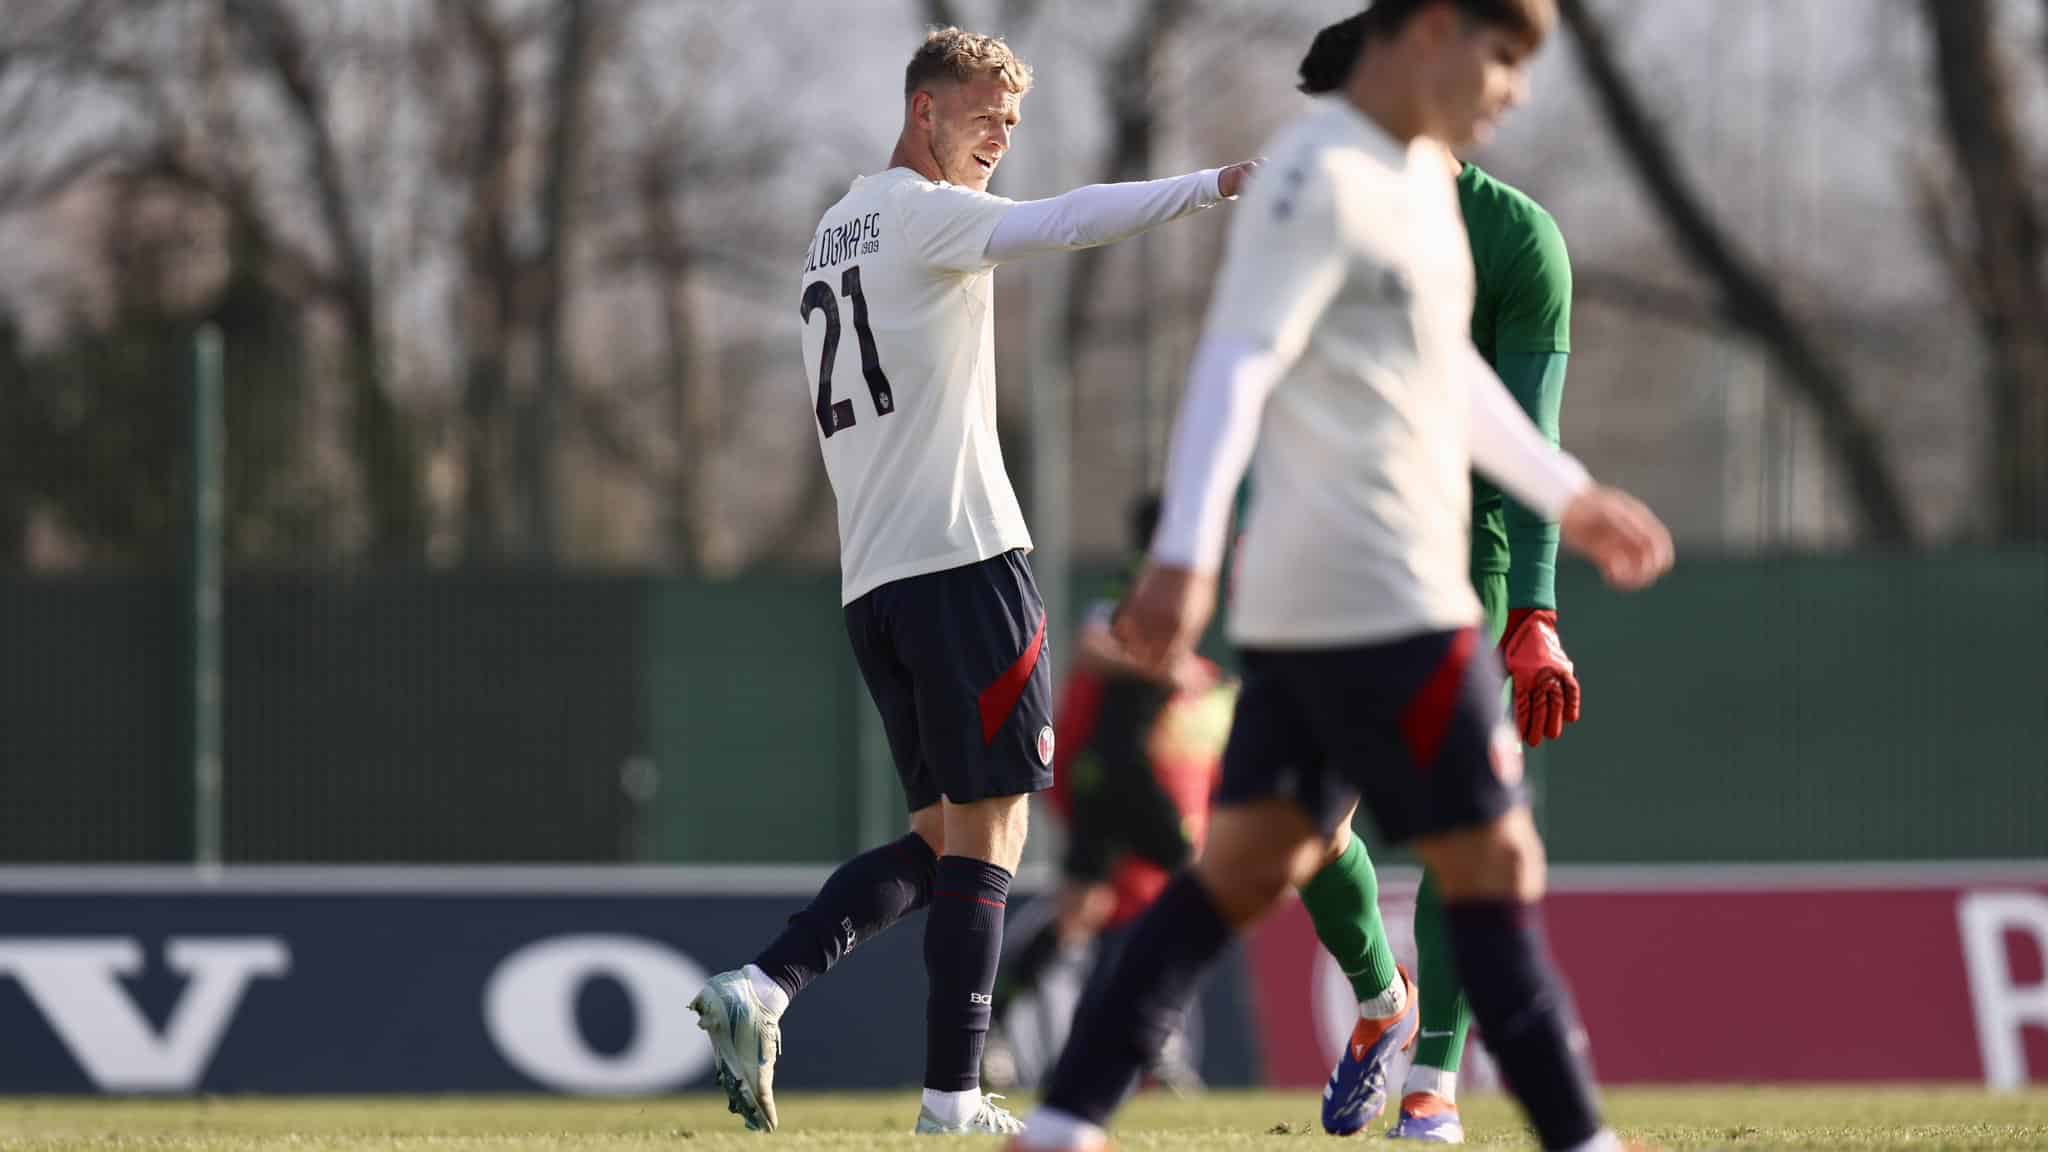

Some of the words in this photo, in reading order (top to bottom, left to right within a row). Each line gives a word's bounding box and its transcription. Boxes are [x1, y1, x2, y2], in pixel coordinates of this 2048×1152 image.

[805, 218, 861, 272] LOGNA
[864, 212, 880, 240] FC
[800, 265, 895, 439] 21
